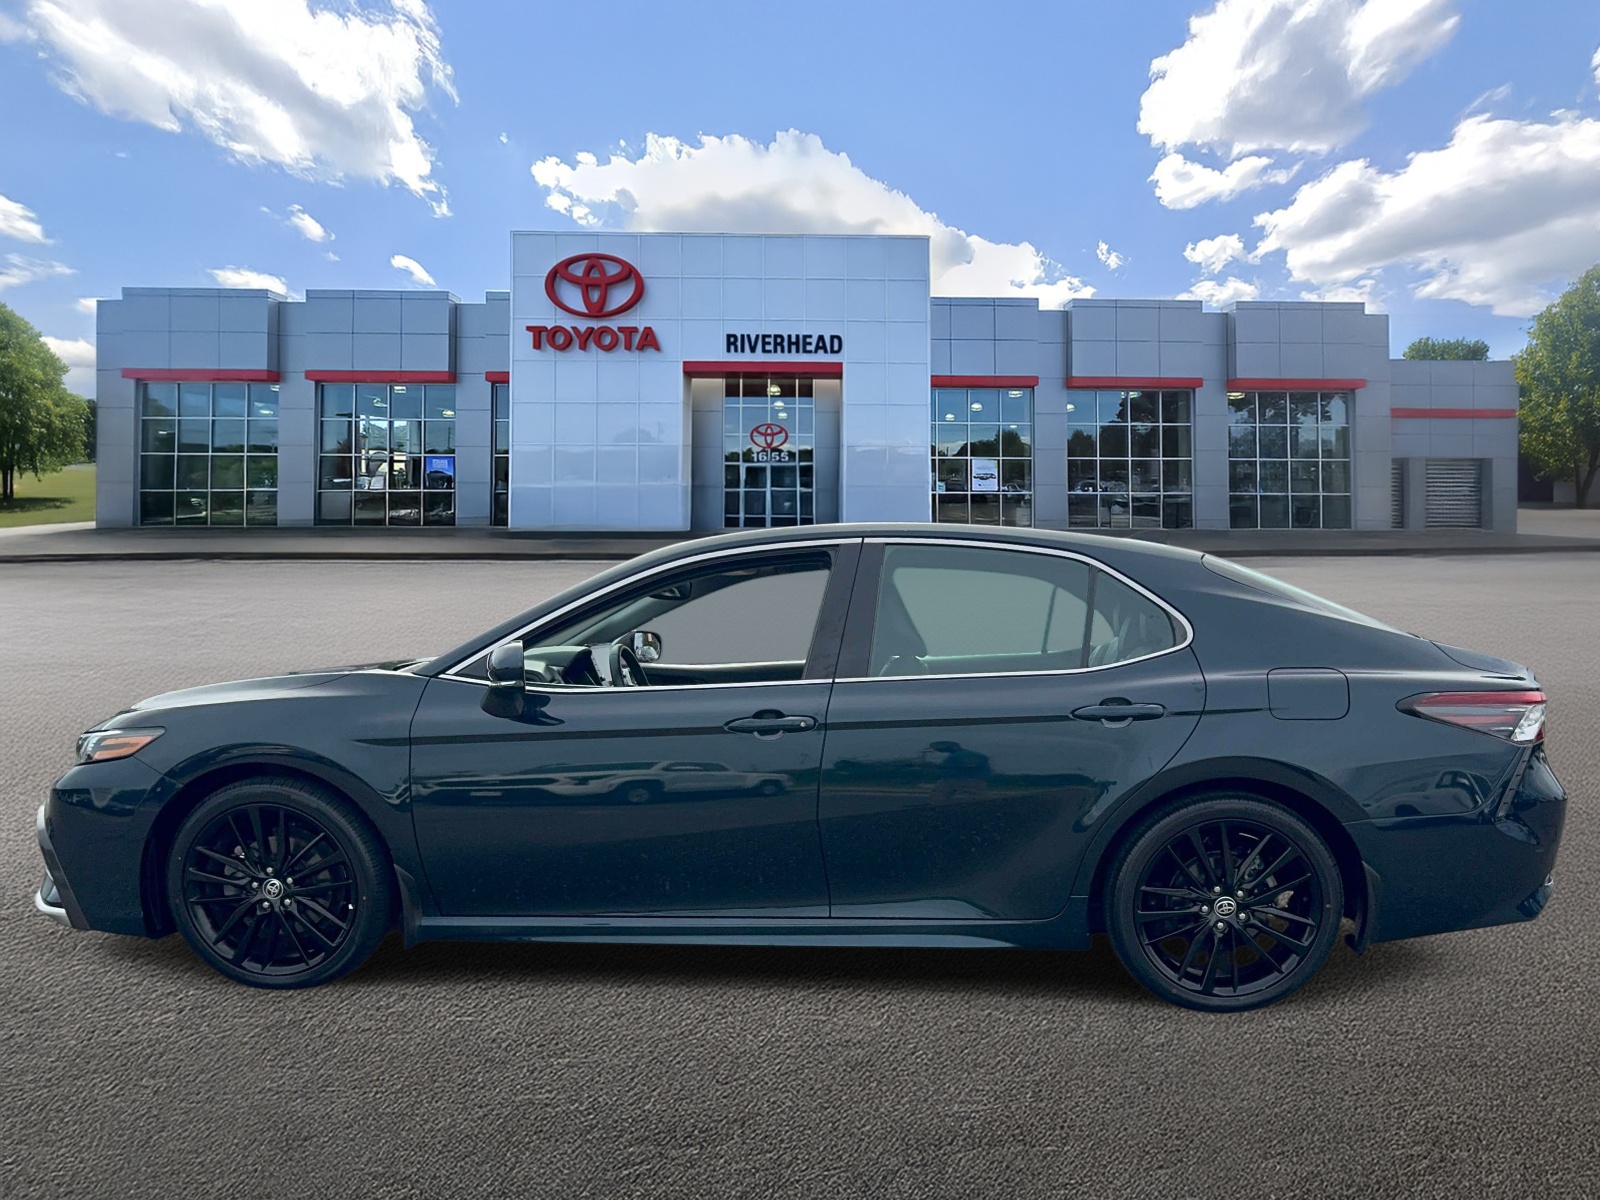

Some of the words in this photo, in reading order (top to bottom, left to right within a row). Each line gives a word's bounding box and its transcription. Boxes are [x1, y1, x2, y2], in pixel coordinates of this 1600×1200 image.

[526, 325, 661, 352] TOYOTA
[725, 333, 844, 355] RIVERHEAD
[752, 451, 789, 462] 1655
